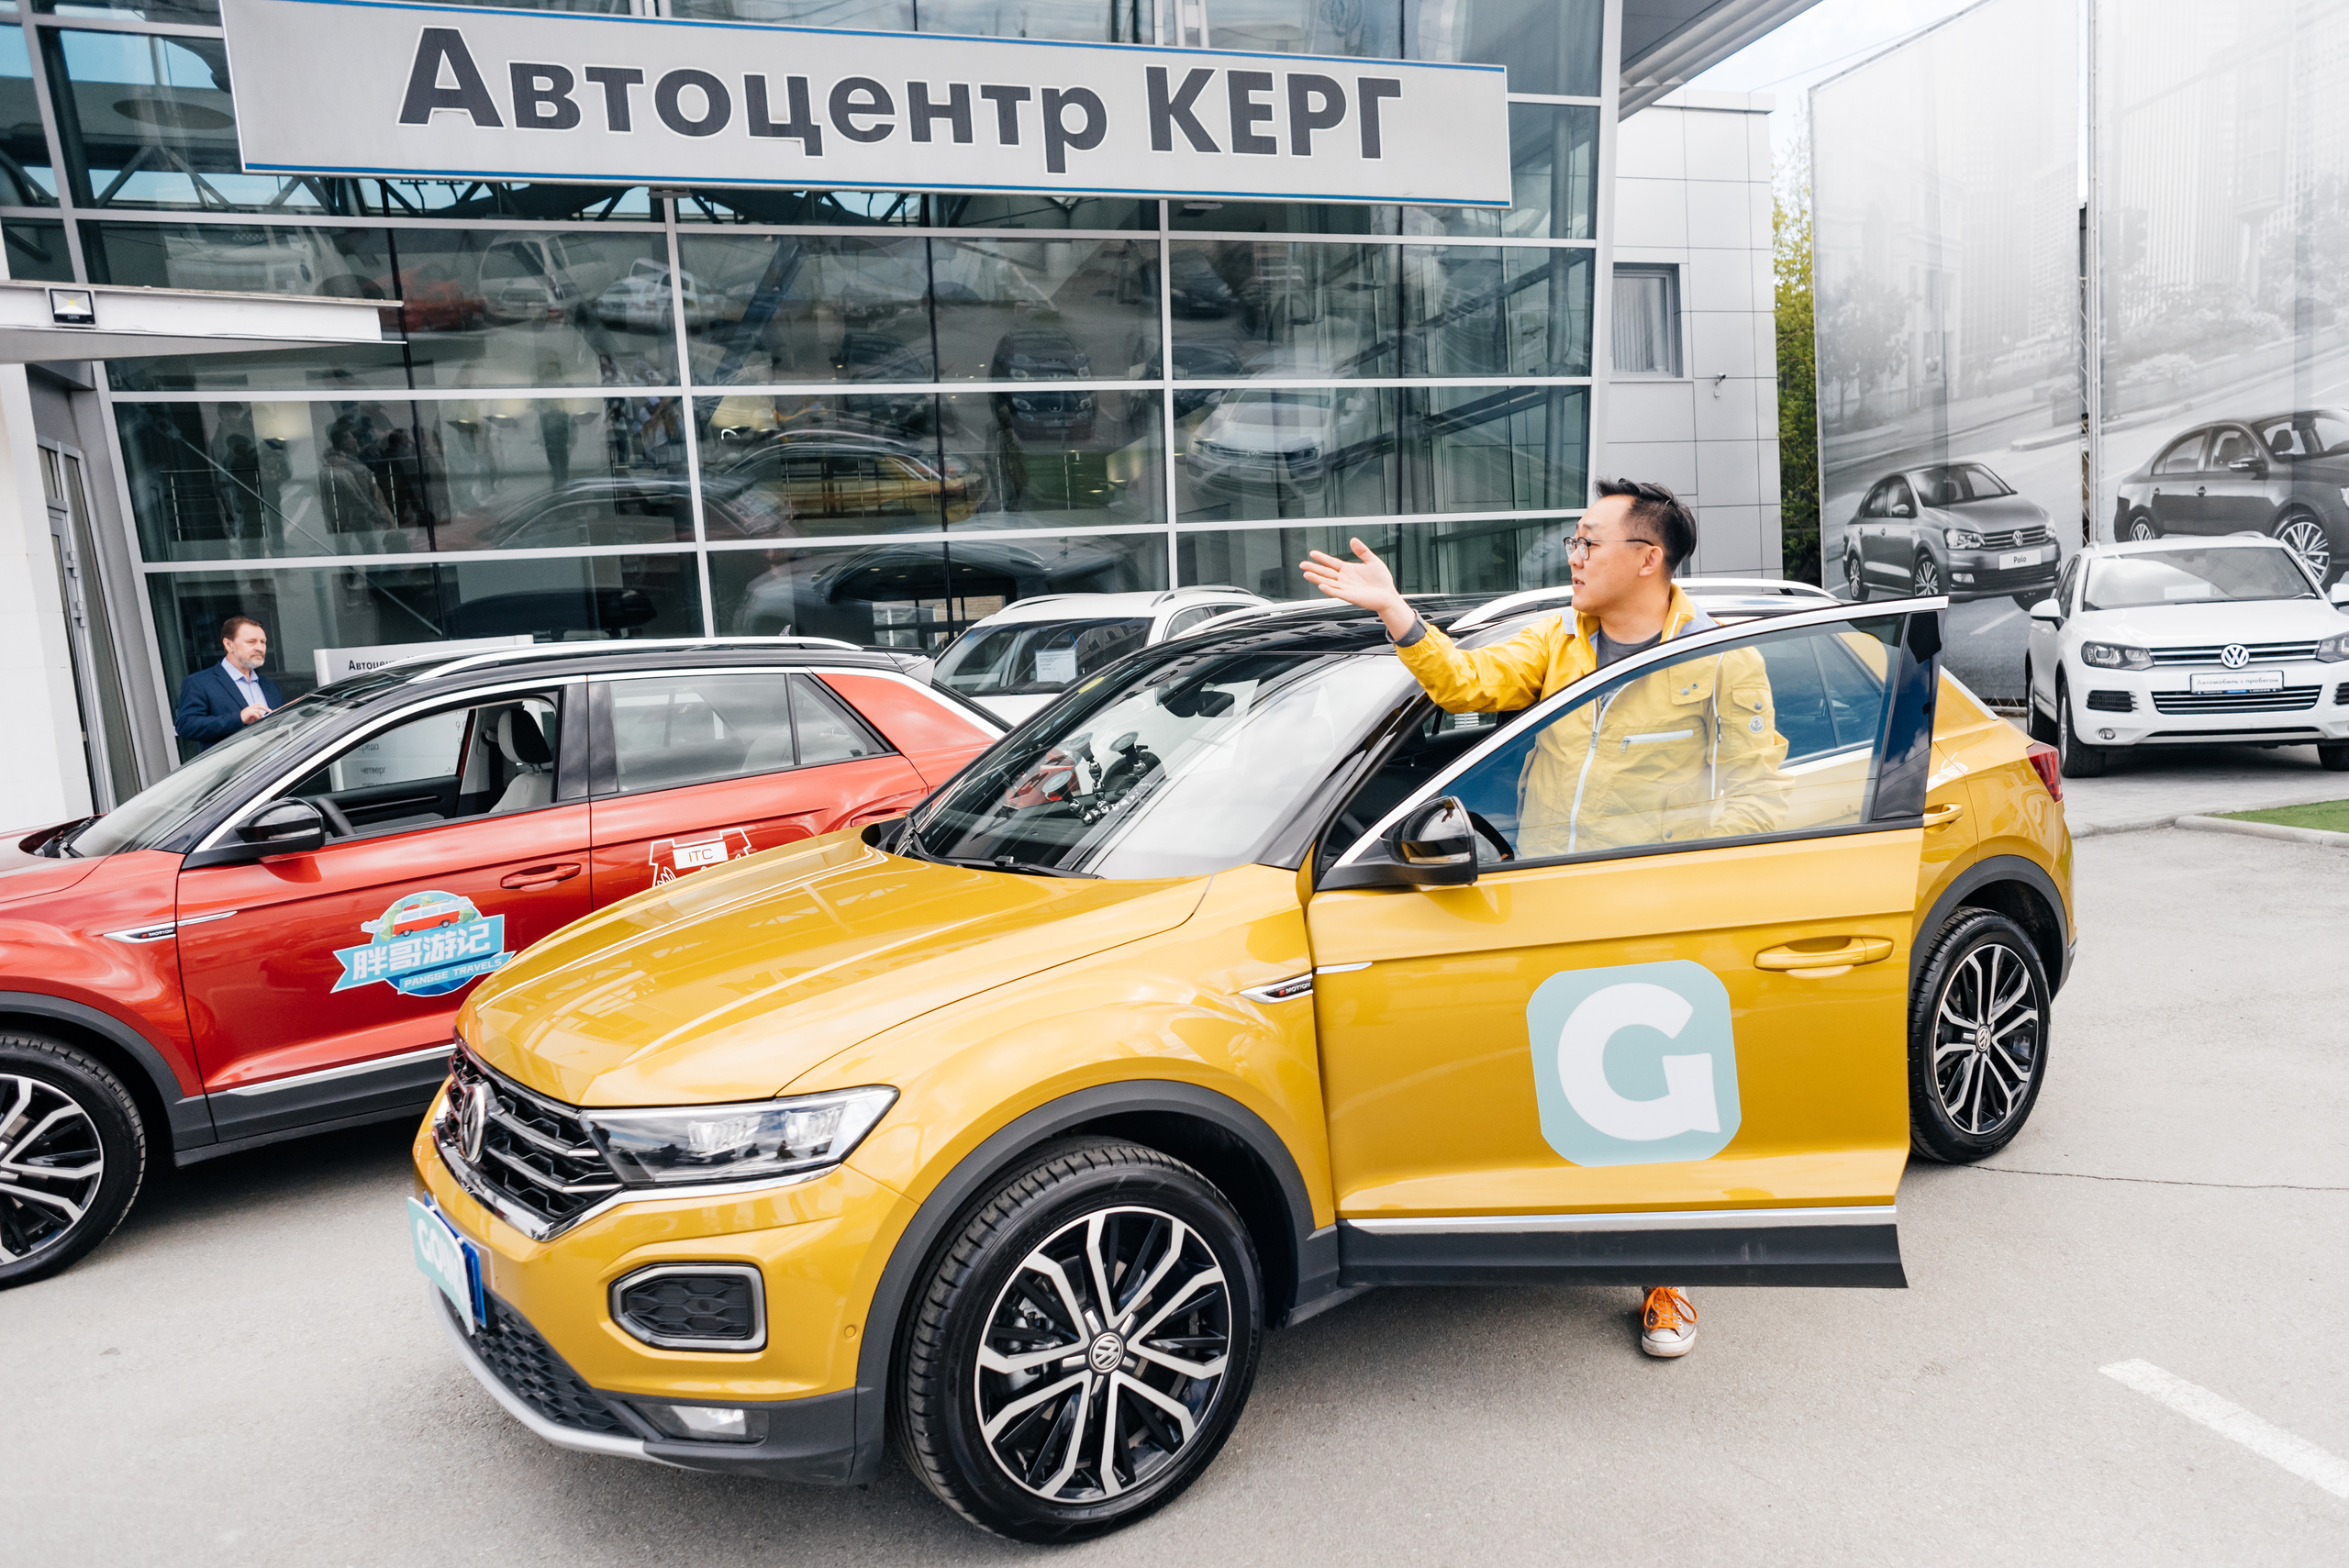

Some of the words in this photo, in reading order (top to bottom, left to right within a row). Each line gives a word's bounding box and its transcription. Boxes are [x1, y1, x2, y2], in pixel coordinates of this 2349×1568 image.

[397, 26, 1108, 174] Автоцентр
[1145, 65, 1403, 160] КЕРГ
[2013, 555, 2027, 564] Polo
[2245, 677, 2279, 685] пробегом
[688, 848, 713, 862] ITC
[352, 922, 491, 981] 胖哥游记
[404, 971, 449, 988] PANGGE
[452, 959, 502, 976] TRAVELS
[1557, 982, 1721, 1141] G
